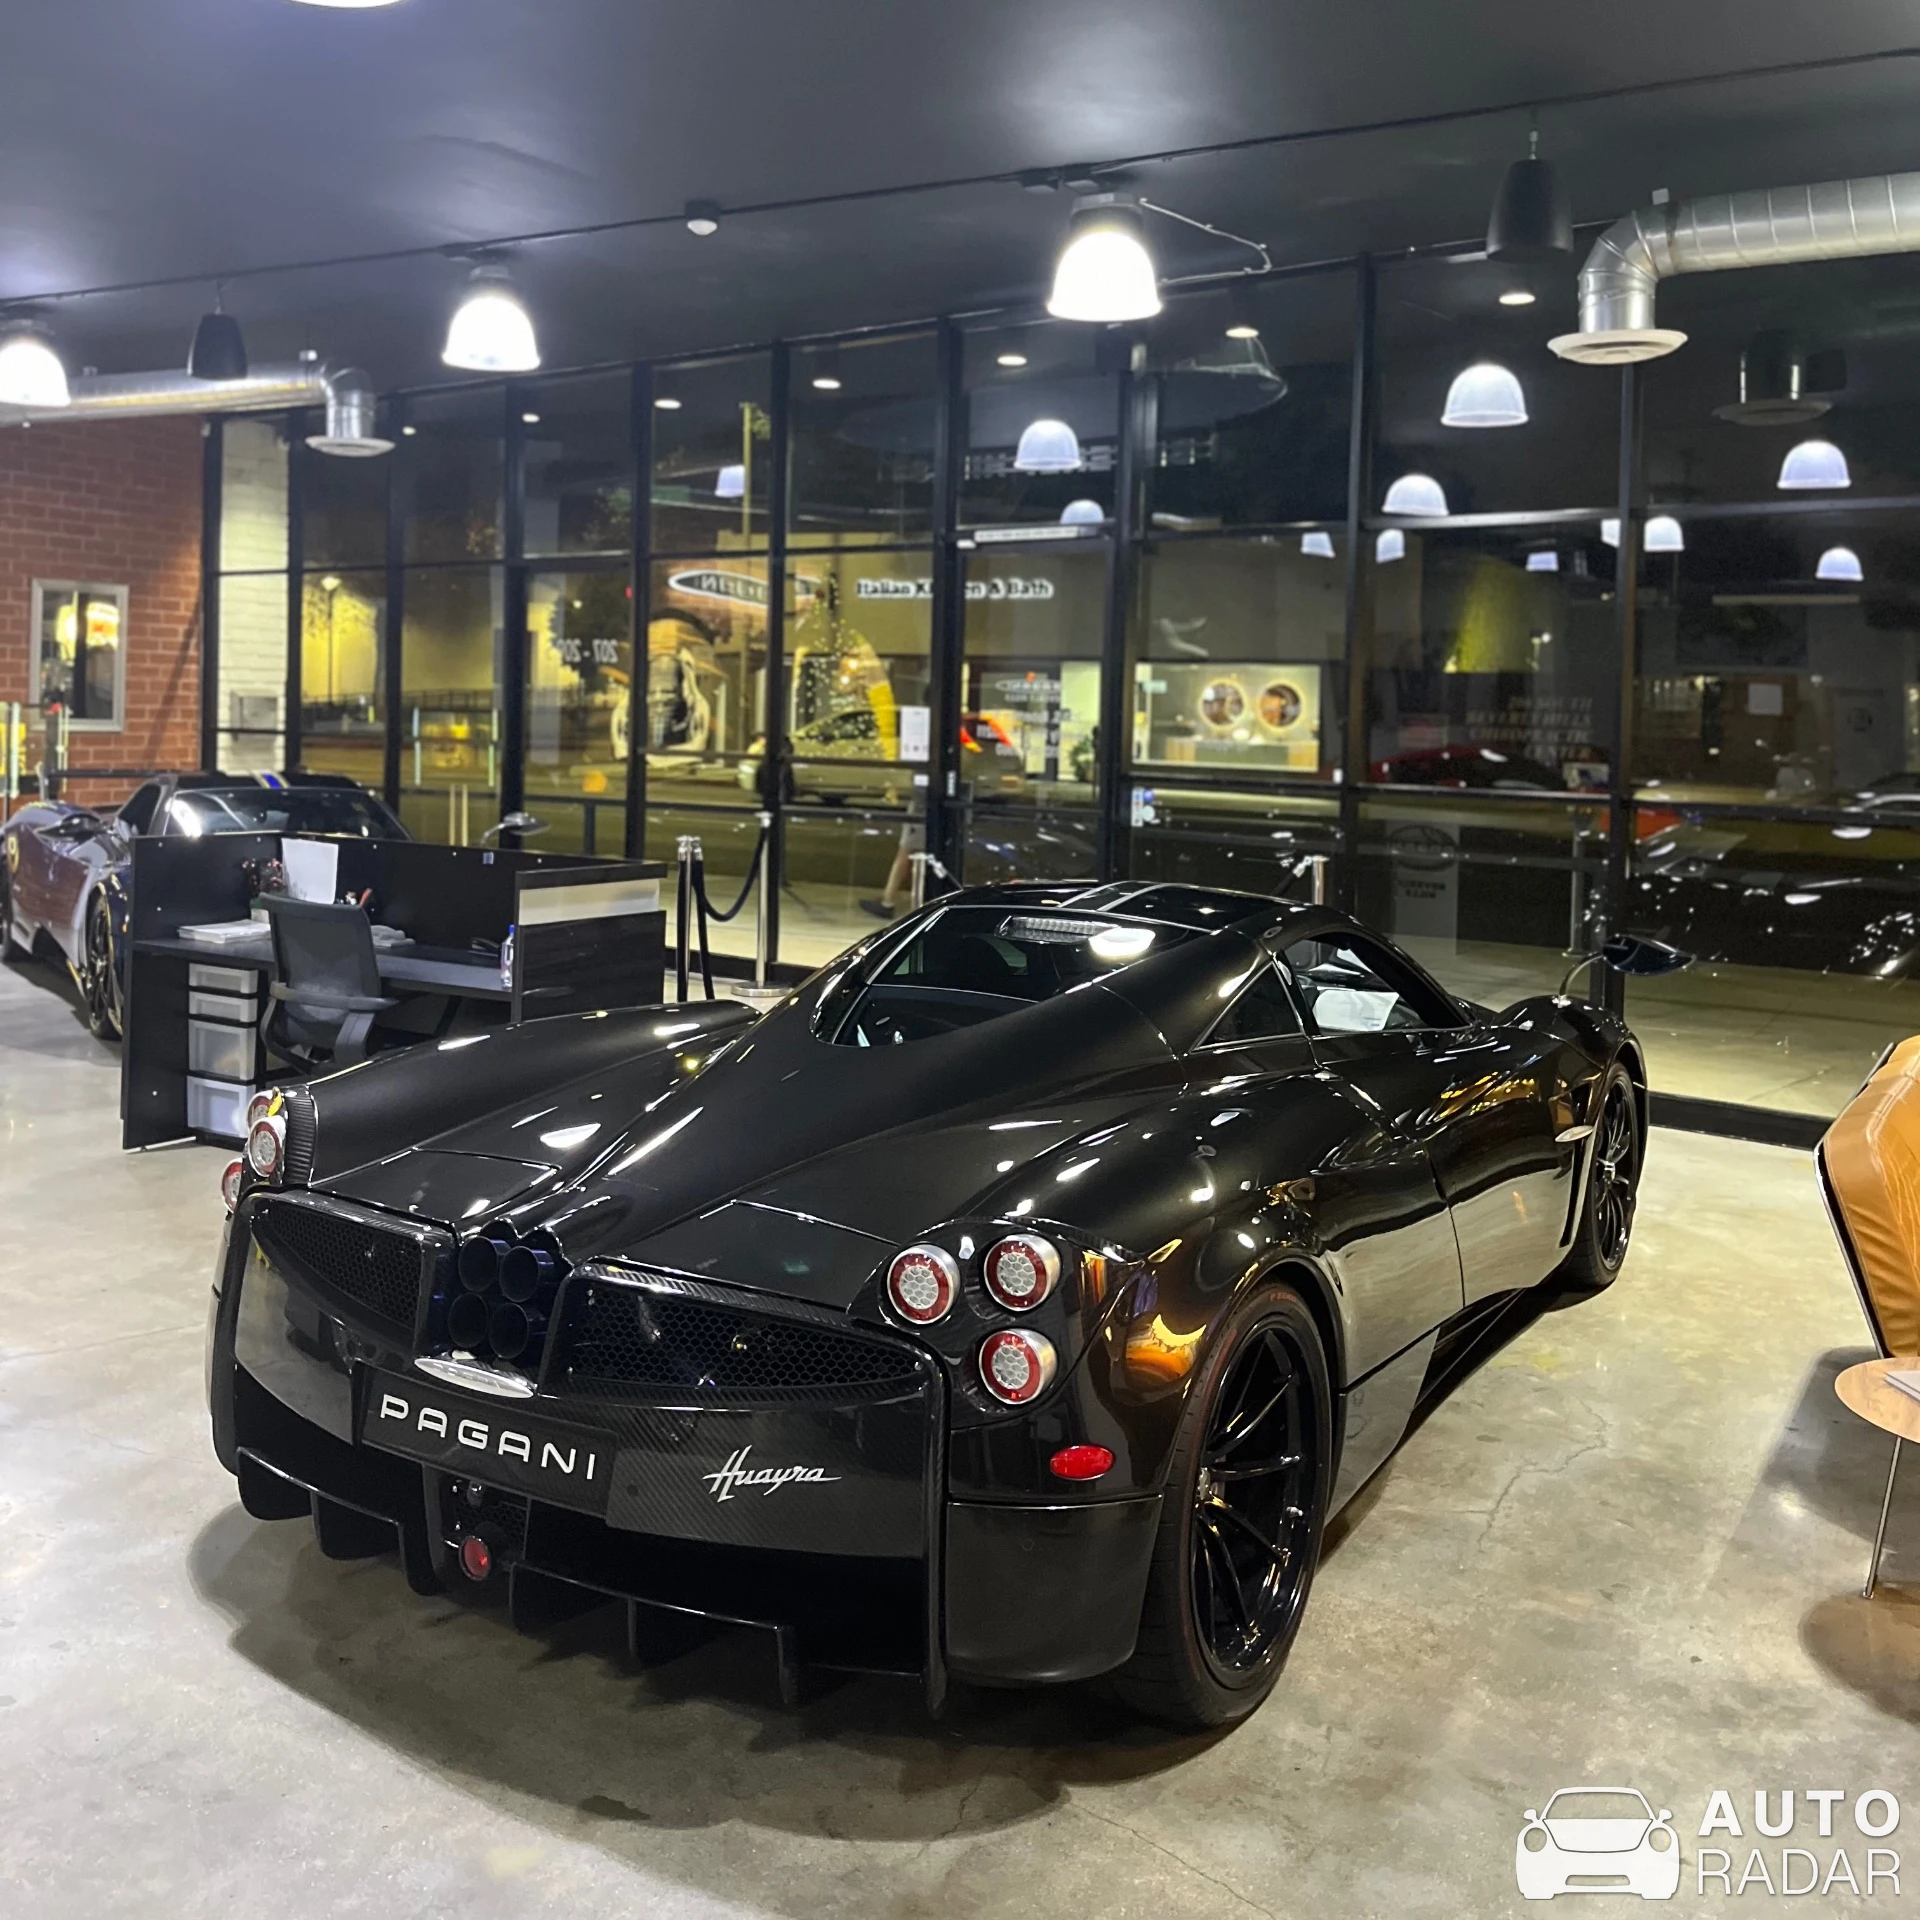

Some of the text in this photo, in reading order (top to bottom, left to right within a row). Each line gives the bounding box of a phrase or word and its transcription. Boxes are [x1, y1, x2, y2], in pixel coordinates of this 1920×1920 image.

[857, 579, 915, 598] Italian
[1007, 578, 1053, 599] Bath
[380, 1393, 596, 1480] PAGANI
[702, 1444, 842, 1503] Huayra
